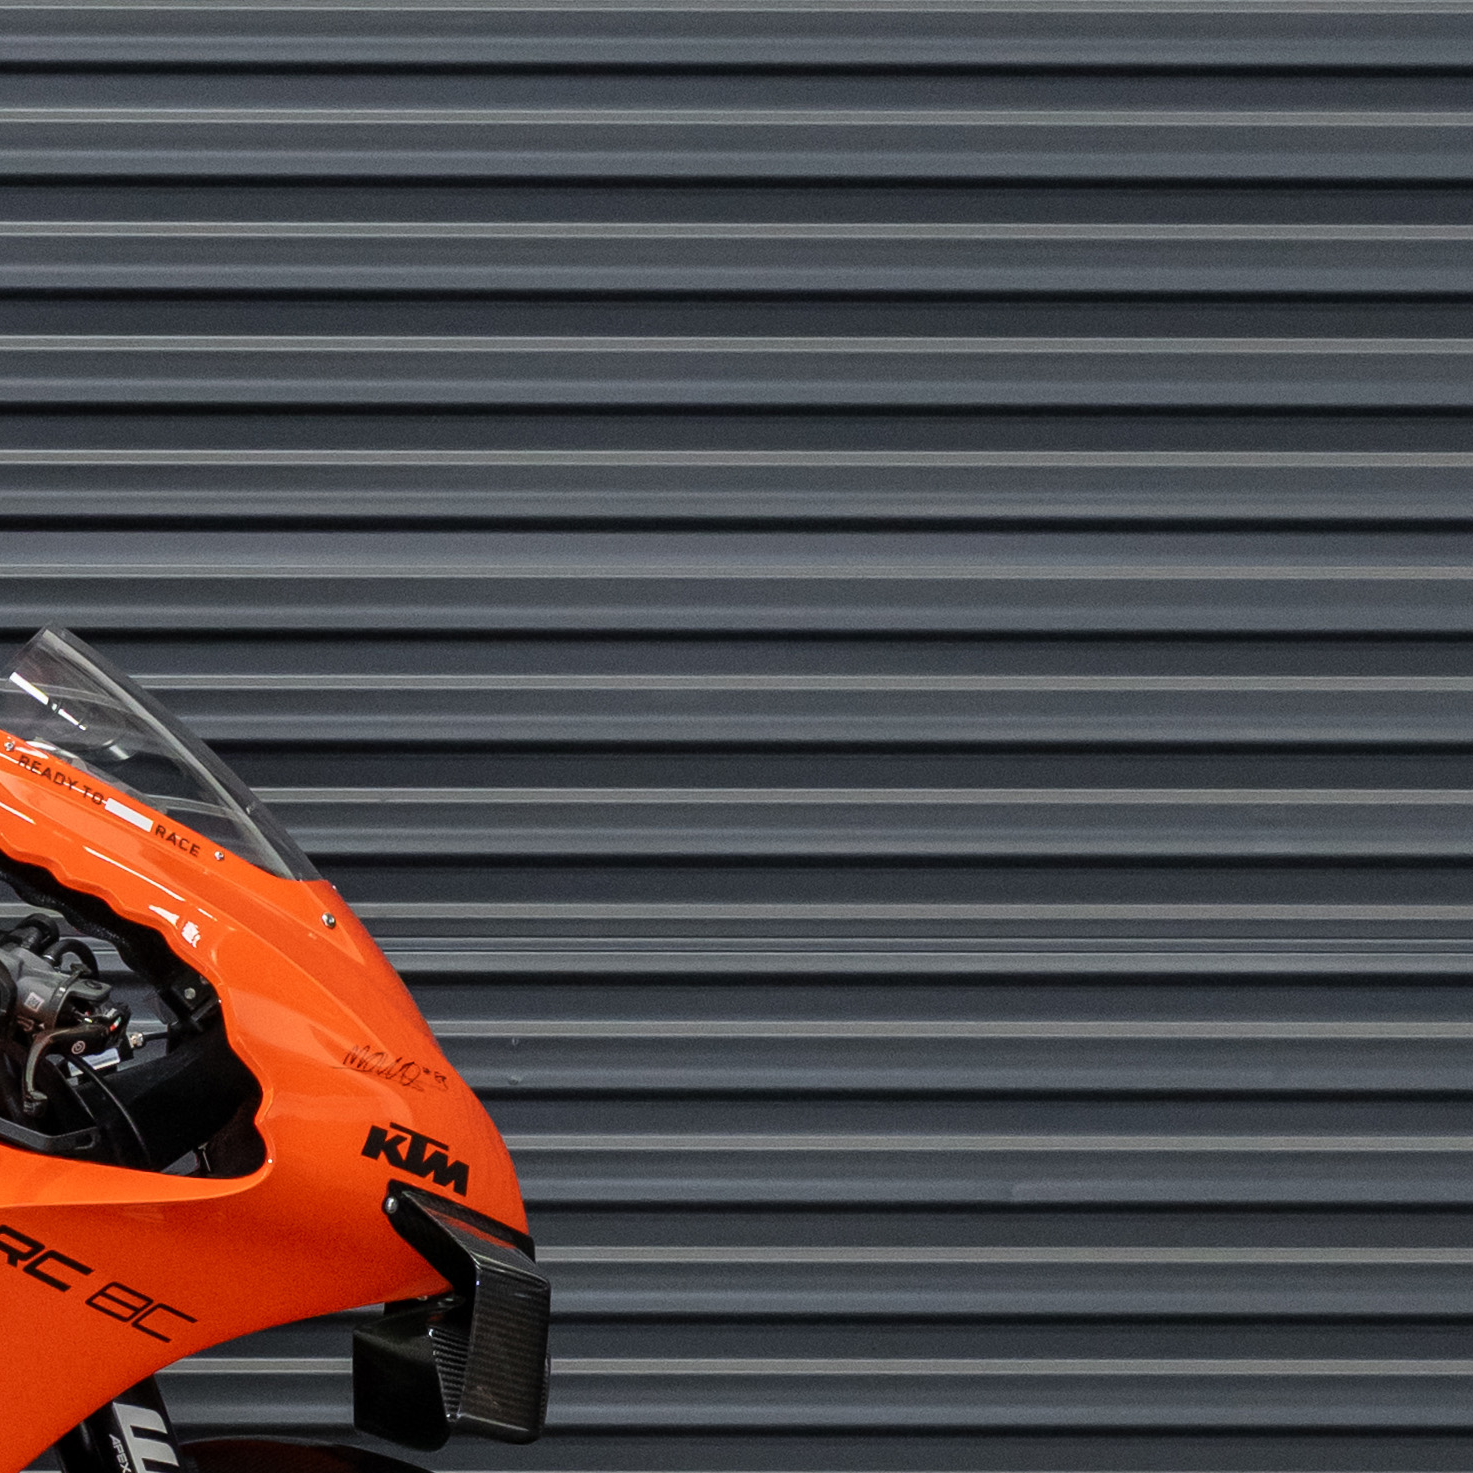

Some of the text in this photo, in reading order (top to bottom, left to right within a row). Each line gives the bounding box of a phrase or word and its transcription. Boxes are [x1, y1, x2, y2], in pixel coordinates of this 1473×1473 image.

[18, 754, 201, 858] READY TO RACE
[360, 1122, 470, 1197] KTM
[85, 1281, 198, 1343] 8C
